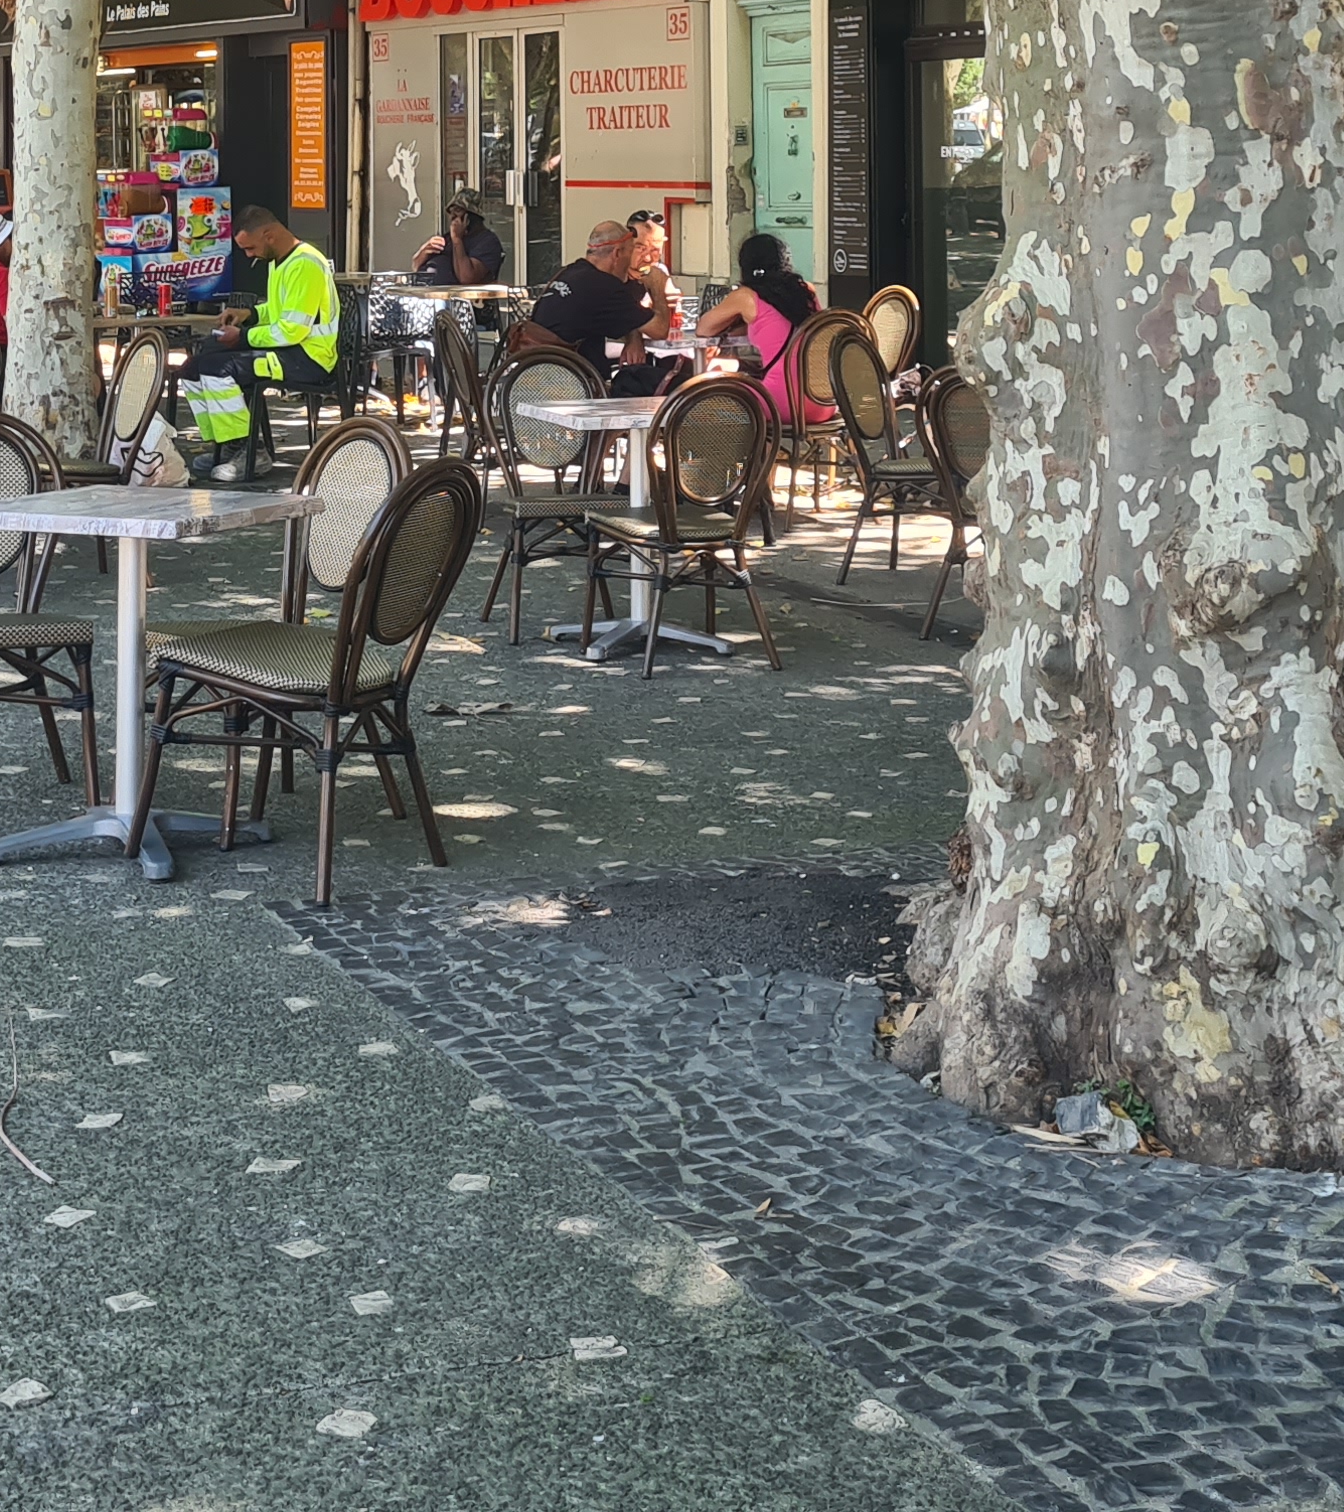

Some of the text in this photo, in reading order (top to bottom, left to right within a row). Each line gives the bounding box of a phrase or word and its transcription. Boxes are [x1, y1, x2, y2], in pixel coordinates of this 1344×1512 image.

[106, 0, 170, 22] Le Palais des Pains
[669, 13, 688, 35] 35
[374, 39, 388, 57] 35
[397, 79, 407, 92] LA
[569, 64, 688, 95] CHARCUTERIE
[586, 103, 670, 130] TRAITEUR
